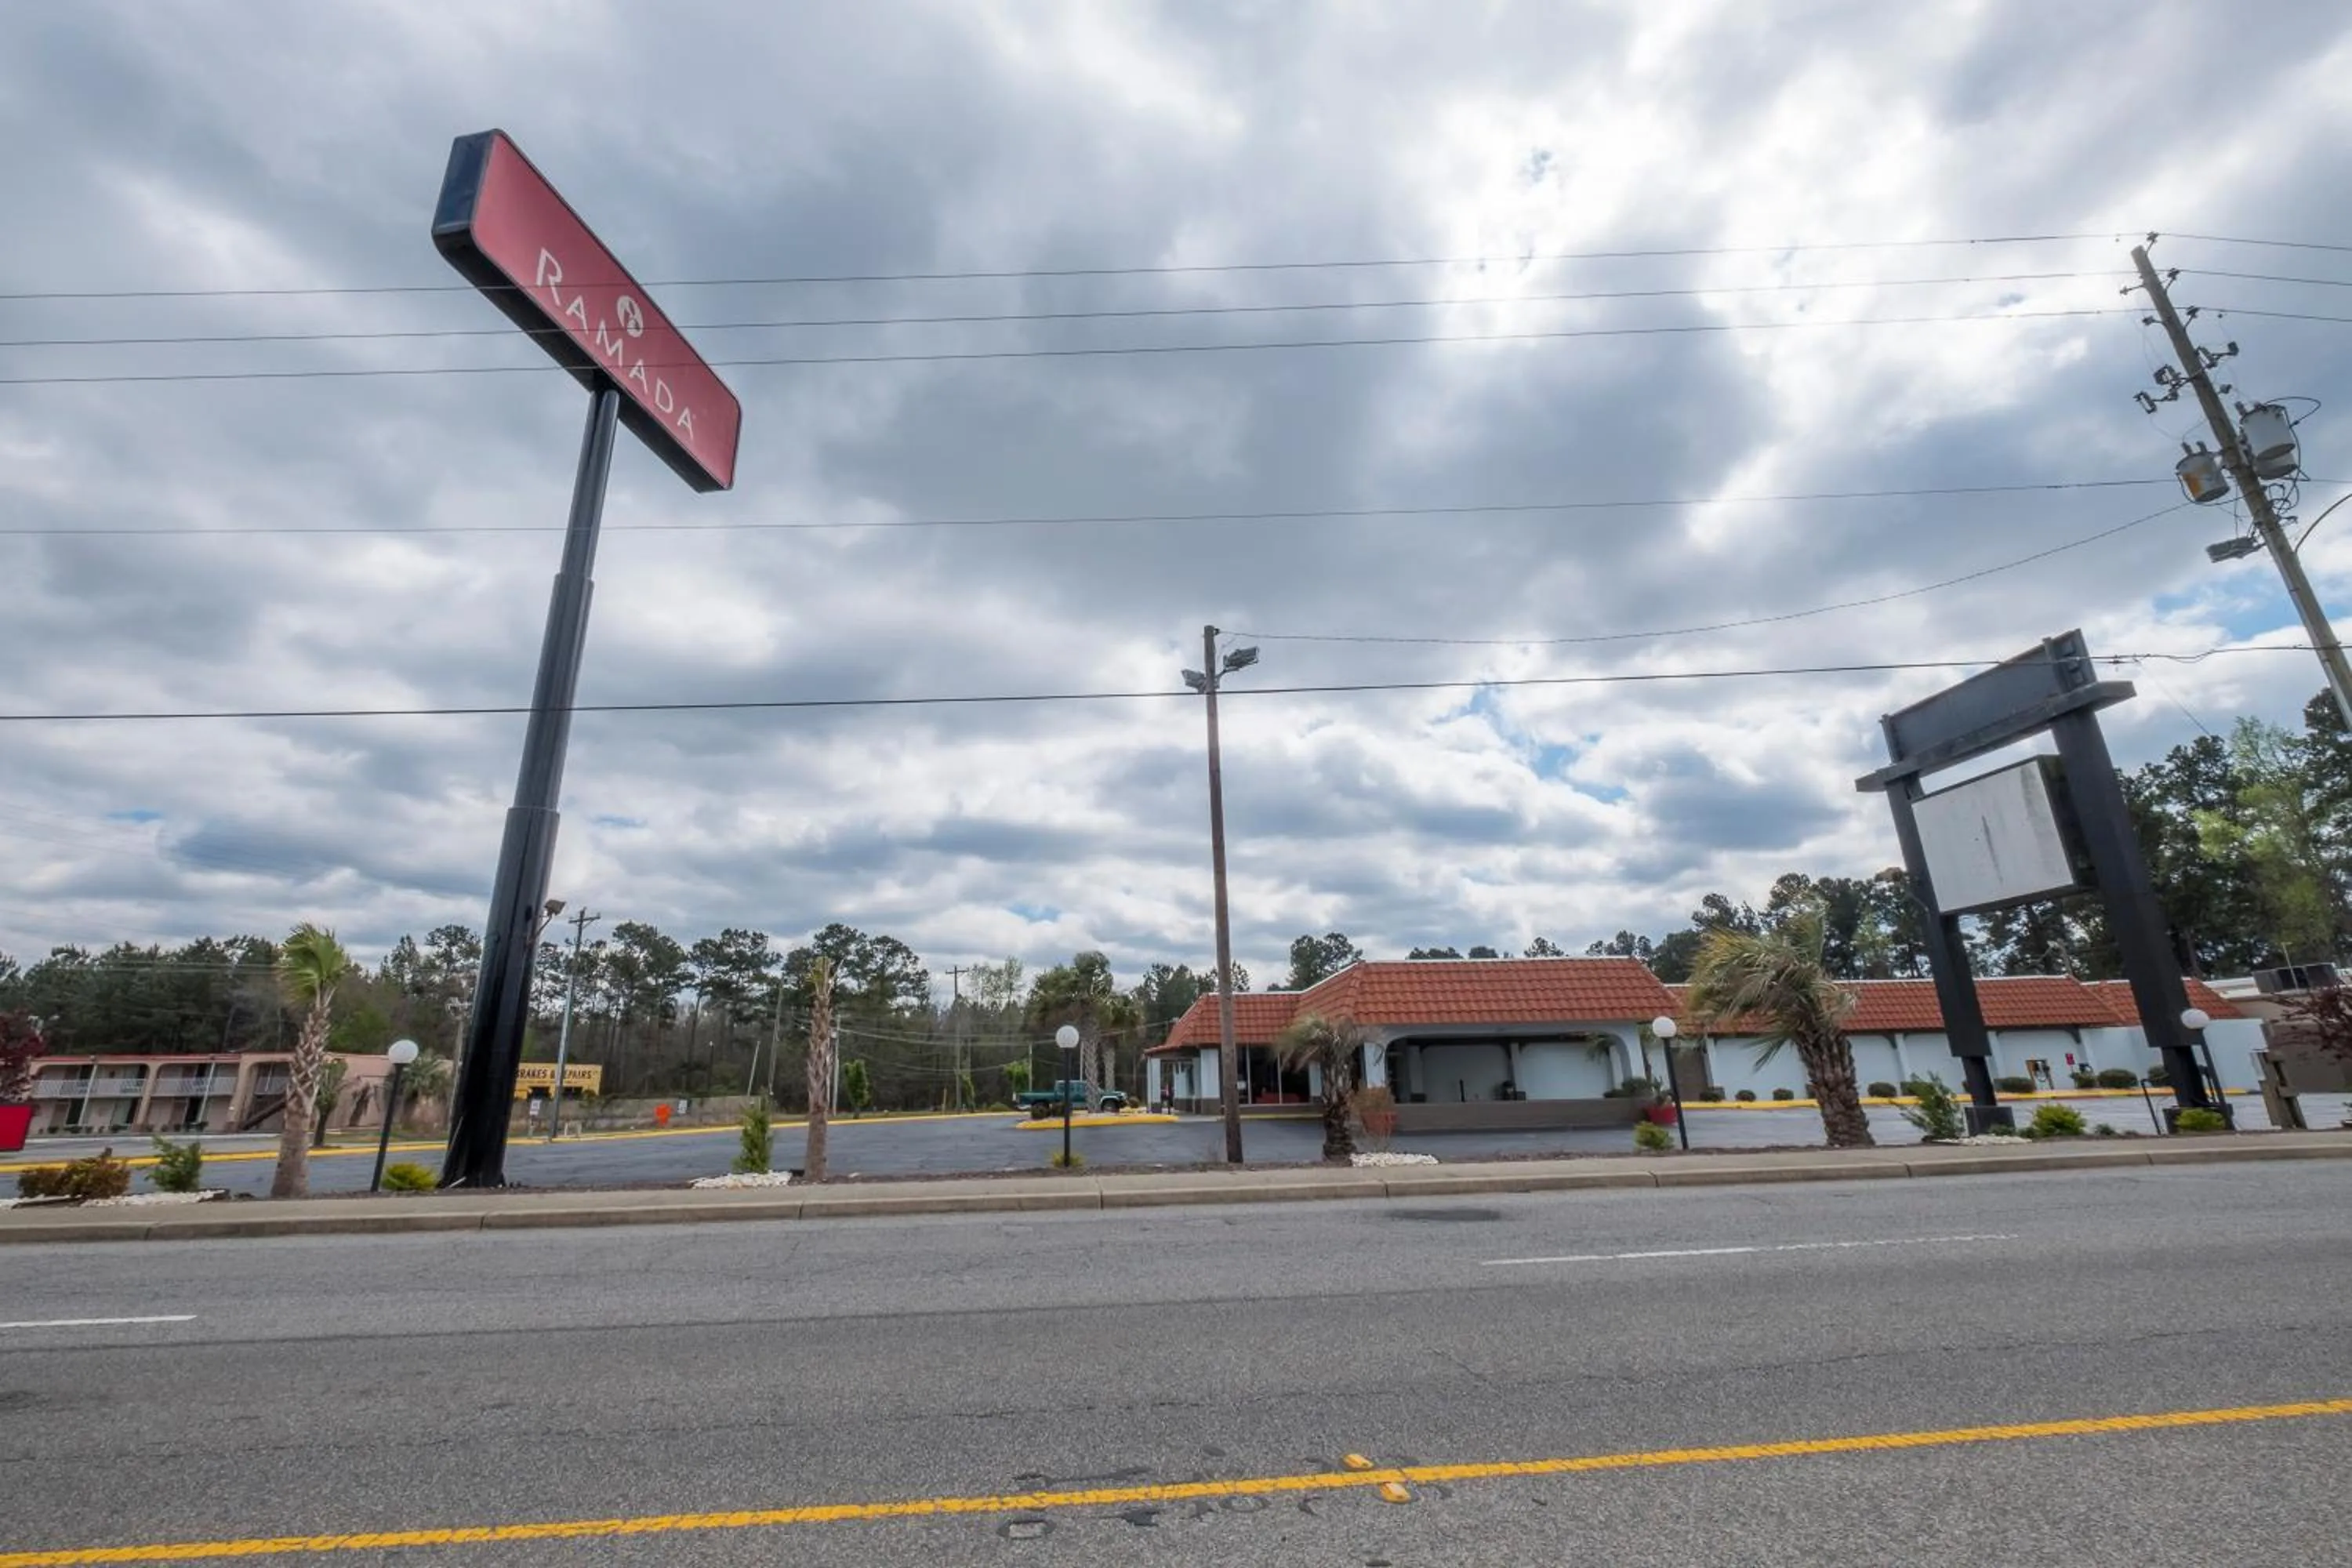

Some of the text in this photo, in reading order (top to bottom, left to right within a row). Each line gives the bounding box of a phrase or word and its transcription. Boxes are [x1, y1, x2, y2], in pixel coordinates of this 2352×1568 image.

[536, 247, 694, 440] RAMADA
[517, 1069, 547, 1079] RAKES
[562, 1069, 592, 1079] EPAIRS
